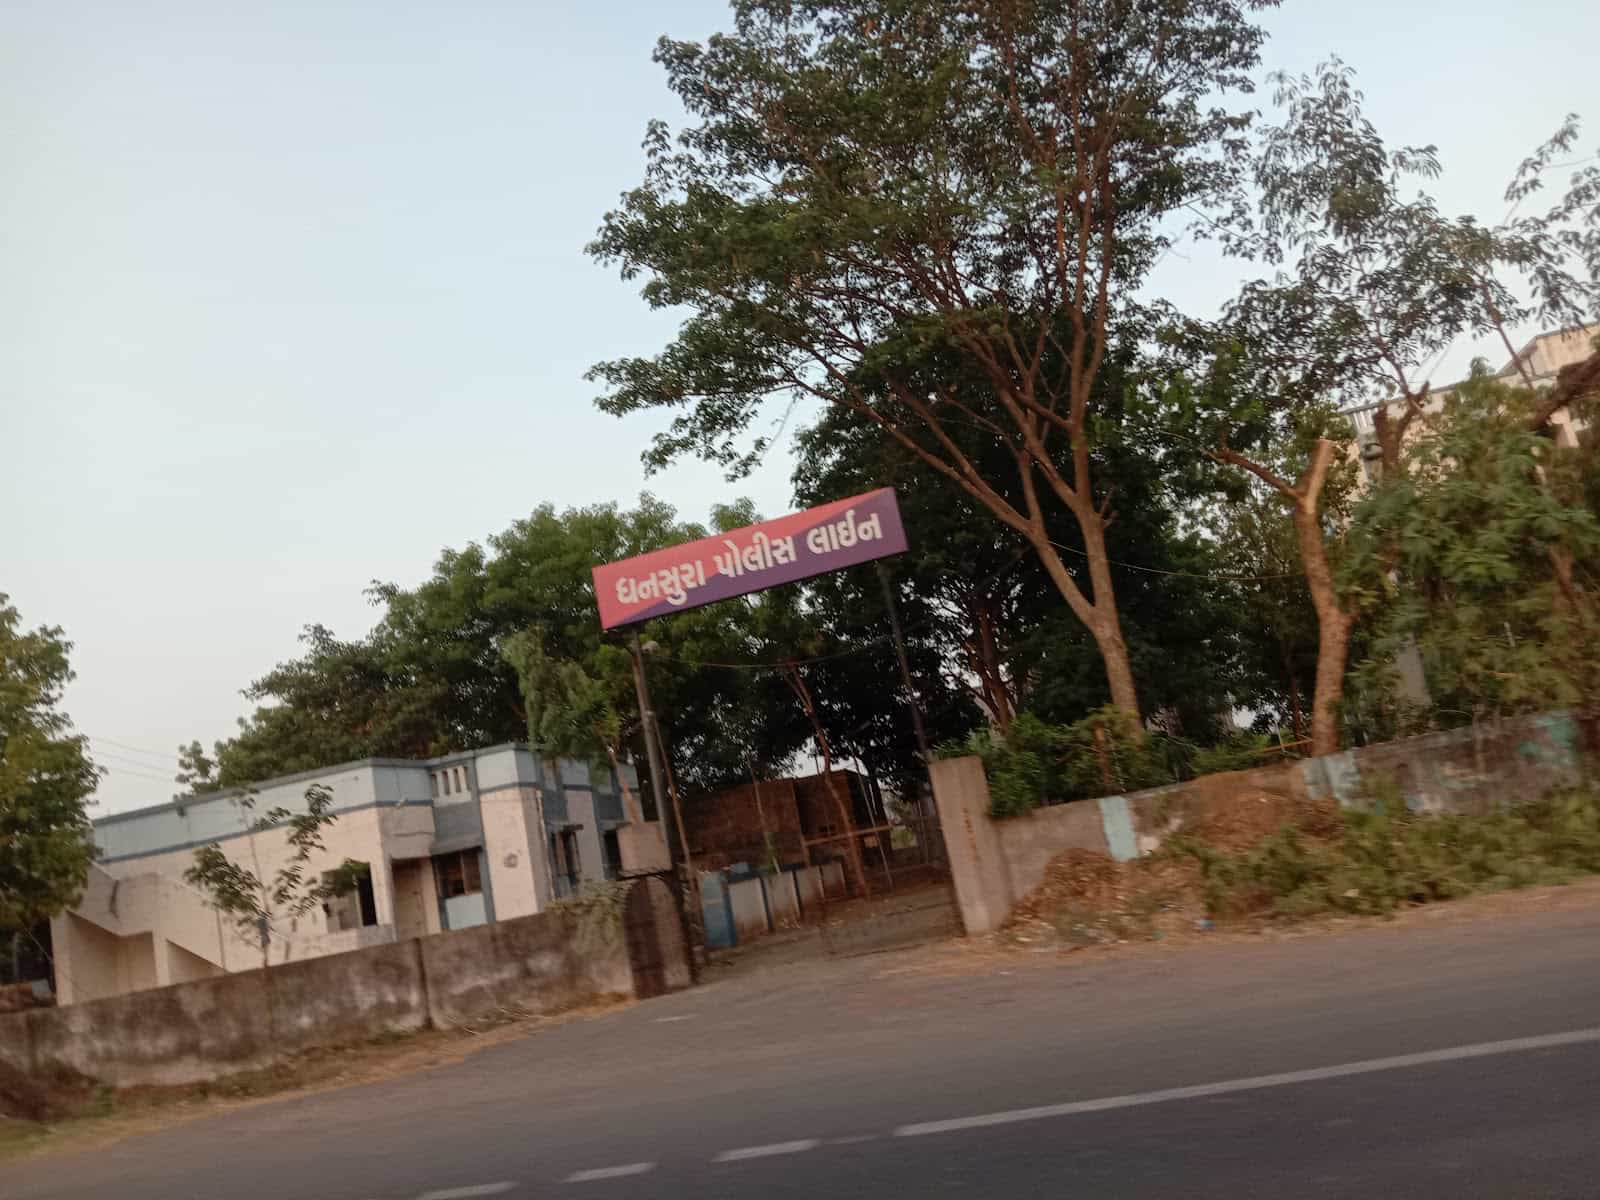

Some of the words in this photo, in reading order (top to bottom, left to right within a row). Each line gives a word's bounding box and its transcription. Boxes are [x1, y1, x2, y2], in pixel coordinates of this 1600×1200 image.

[616, 560, 706, 605] ધનસુરા
[713, 532, 797, 578] પોલીસ
[806, 511, 883, 554] લાઈન
